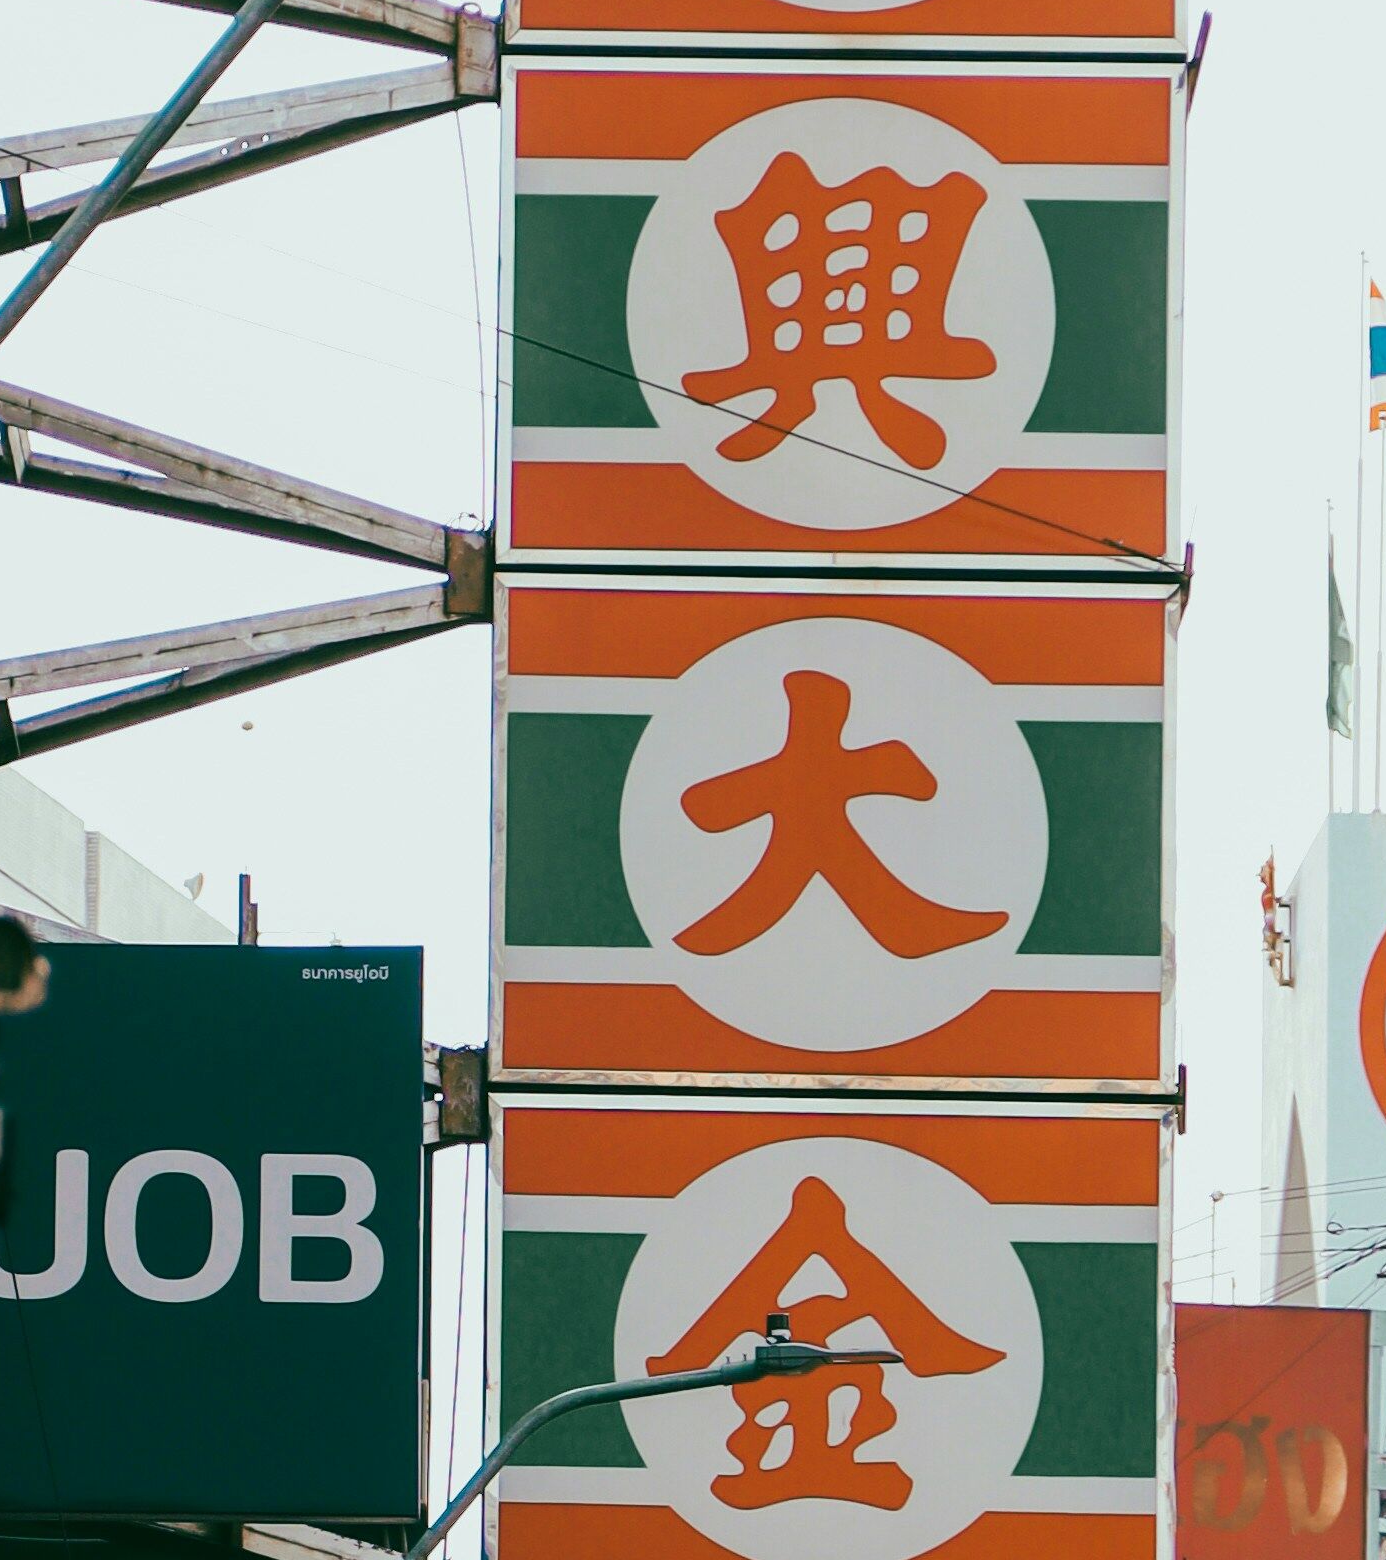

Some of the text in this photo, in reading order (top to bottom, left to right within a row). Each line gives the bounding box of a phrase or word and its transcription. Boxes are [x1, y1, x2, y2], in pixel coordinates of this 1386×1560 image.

[301, 962, 391, 985] ธนาคารยูโอบี
